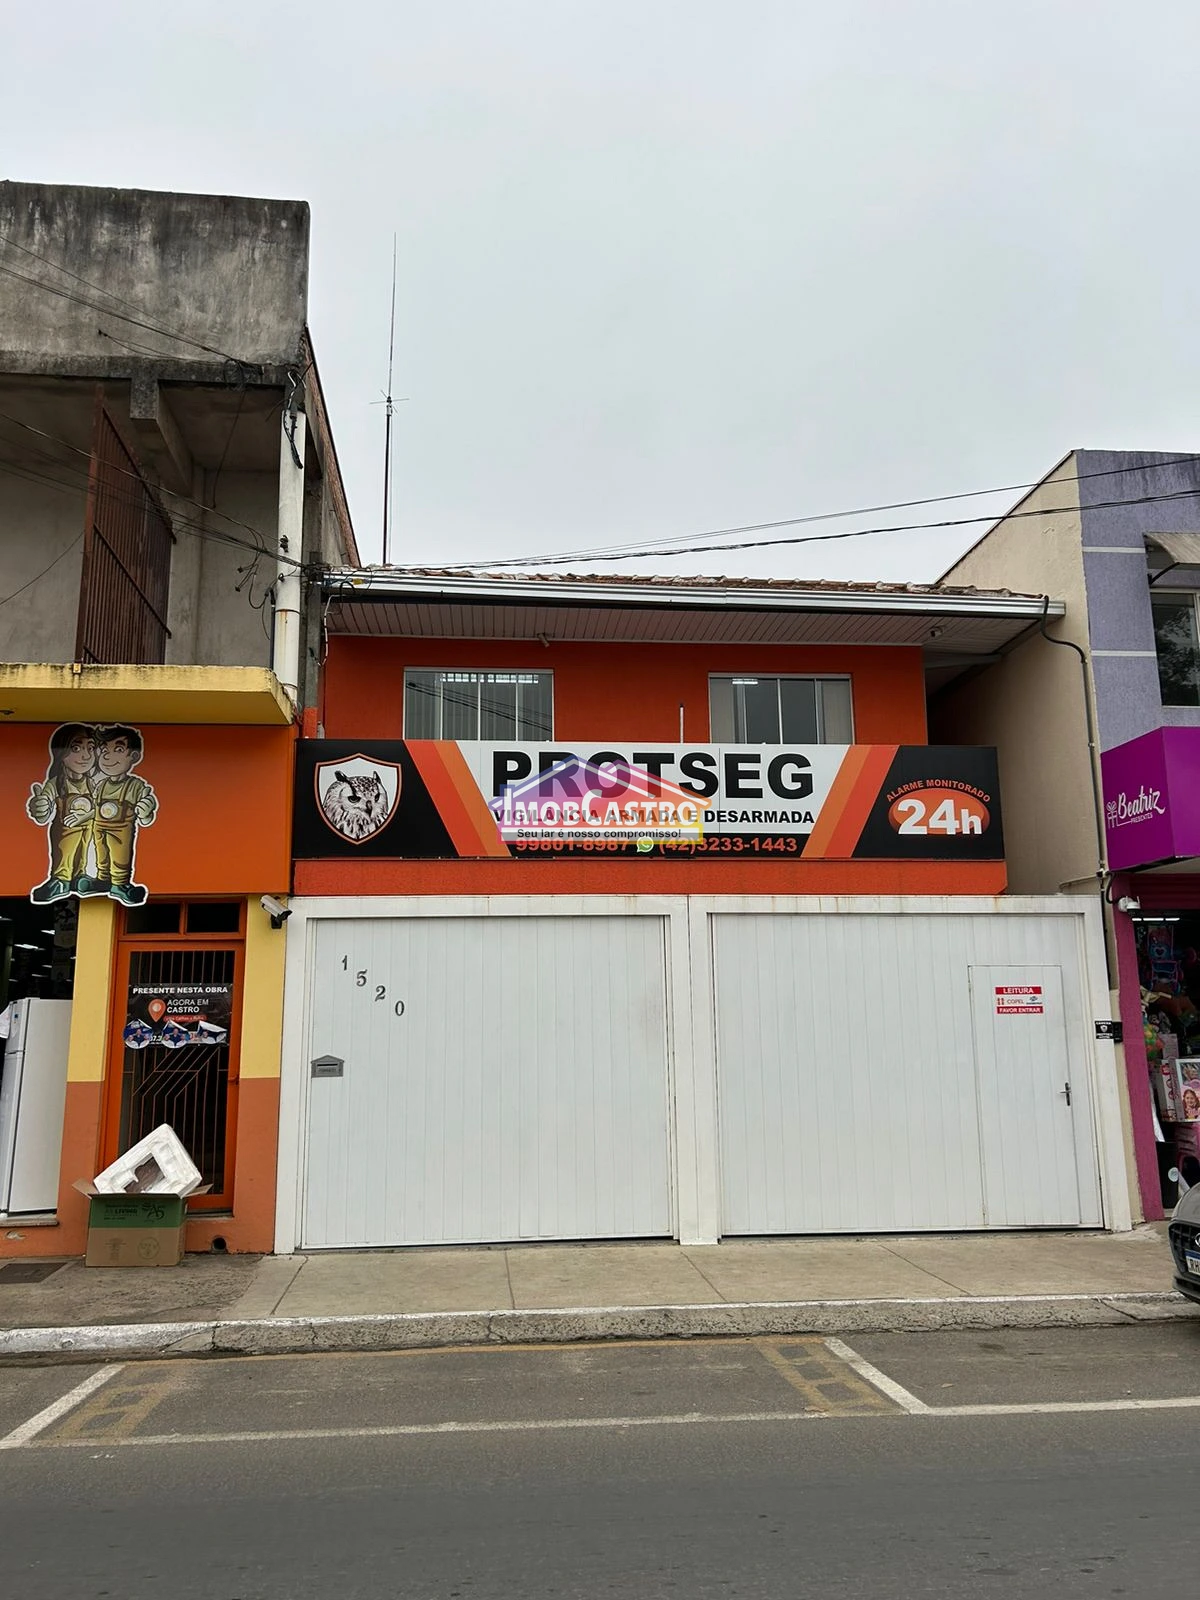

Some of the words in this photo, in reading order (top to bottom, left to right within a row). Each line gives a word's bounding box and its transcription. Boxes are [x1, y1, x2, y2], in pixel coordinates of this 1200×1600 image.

[493, 751, 814, 799] PROTSEG
[886, 781, 924, 802] ALARME
[926, 779, 991, 803] MONITORADO
[1118, 785, 1166, 819] Beatriz
[604, 810, 681, 823] ARMADA
[688, 810, 698, 823] E
[704, 810, 815, 824] DESARMADA
[897, 799, 983, 835] 24h
[516, 838, 629, 851] 99801-8987
[659, 837, 798, 855] (42)3233-1443
[132, 987, 175, 995] PRESENTE
[177, 986, 203, 994] NESTA
